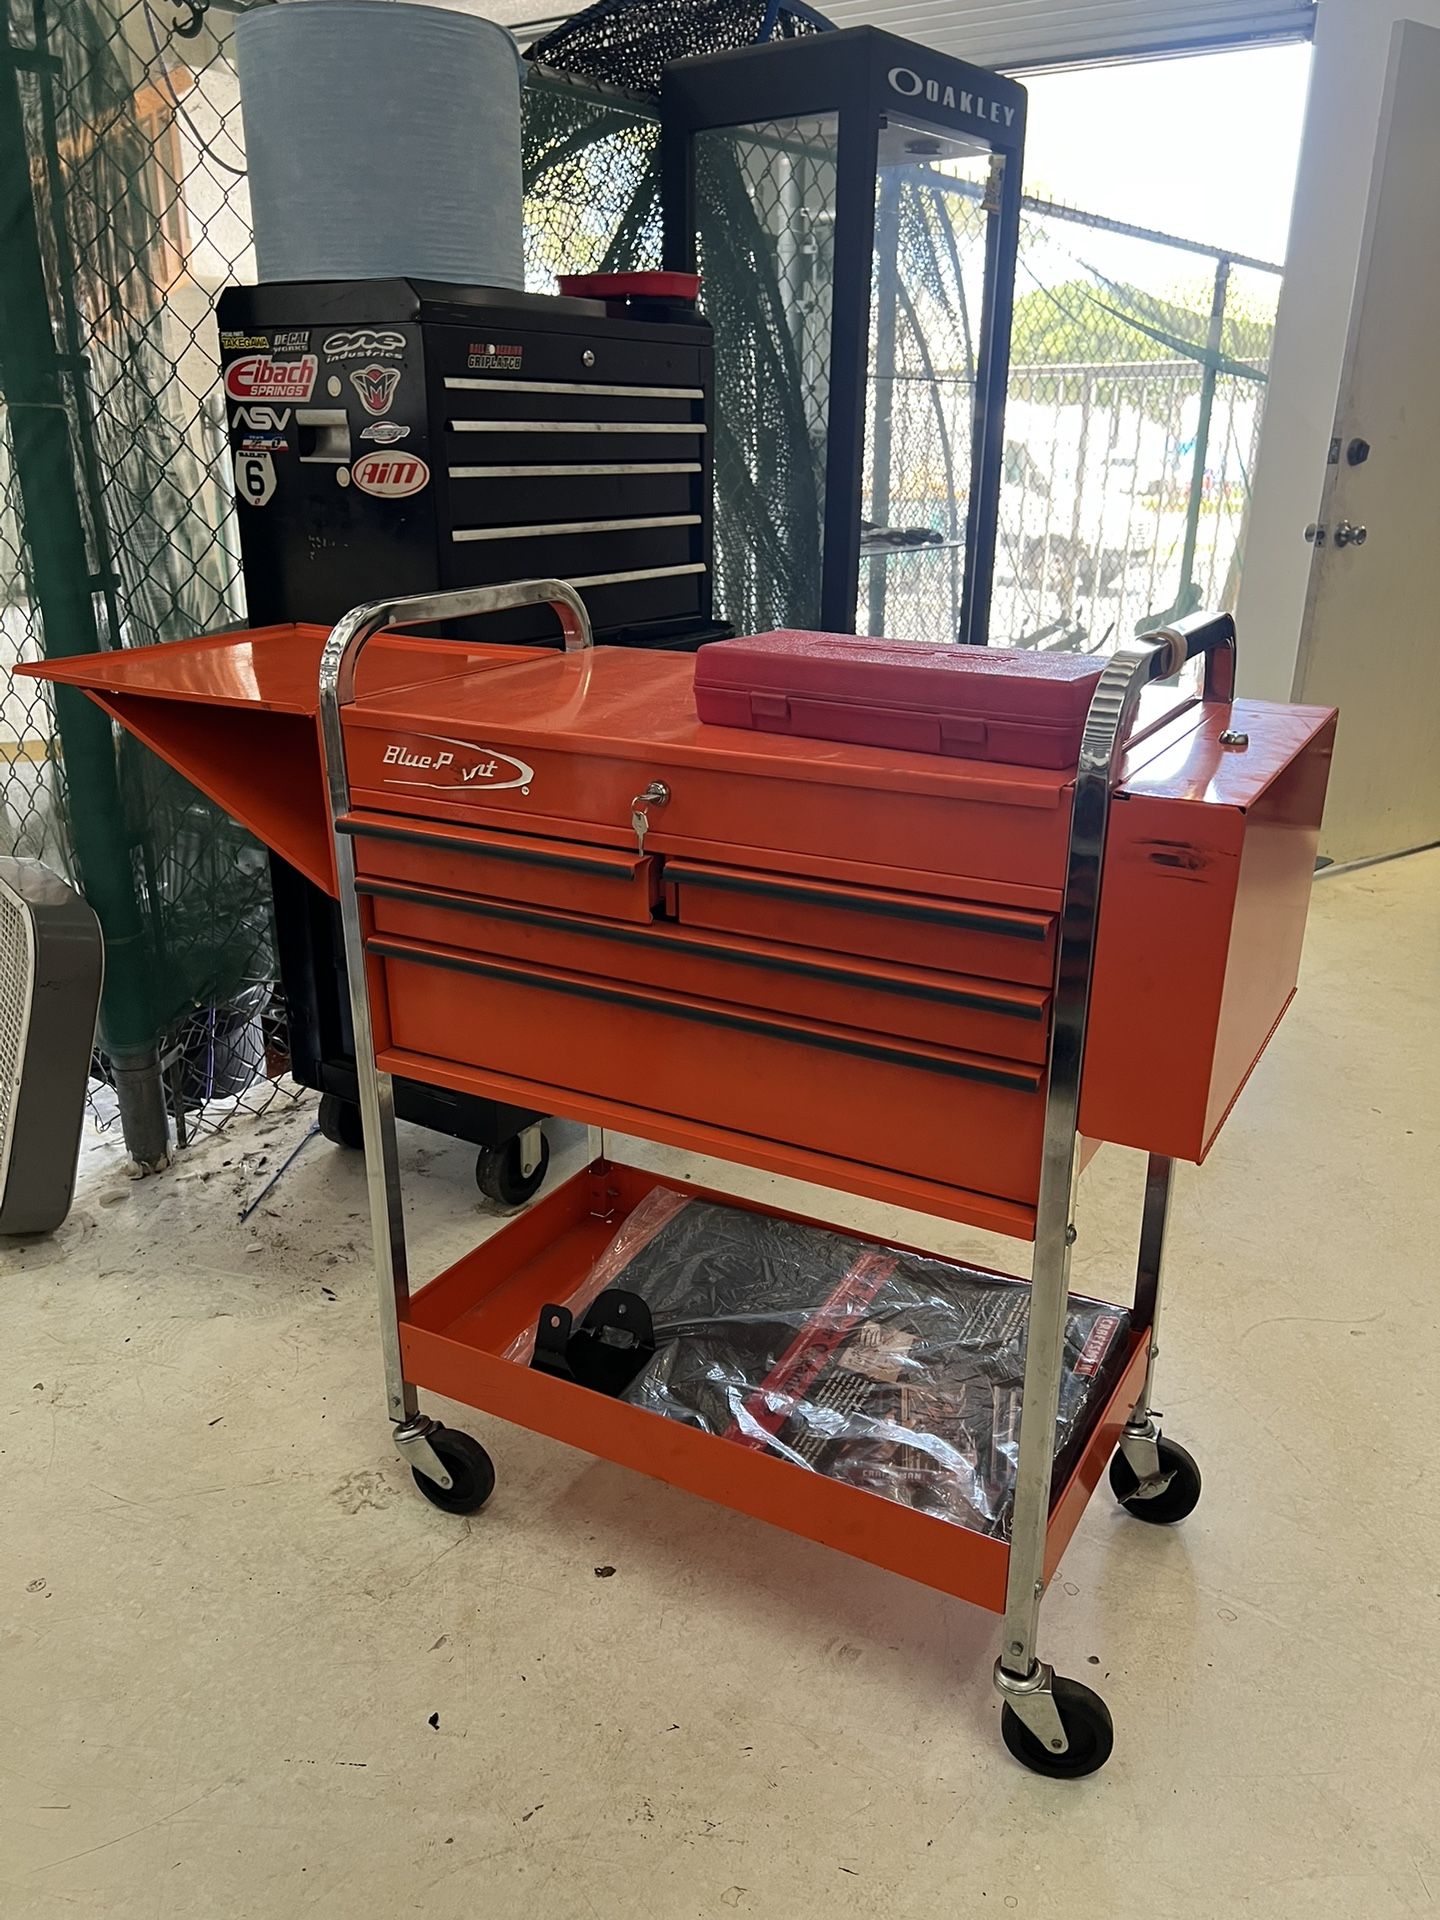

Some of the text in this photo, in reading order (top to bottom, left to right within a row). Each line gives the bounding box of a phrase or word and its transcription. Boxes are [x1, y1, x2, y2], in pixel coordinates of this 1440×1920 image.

[926, 79, 1015, 127] OAKLEY
[221, 336, 270, 349] TAKEGAWA
[274, 331, 310, 346] DECAL
[326, 349, 403, 363] industries
[468, 355, 522, 369] GRIPLATCH
[227, 359, 314, 396] Eibach
[250, 385, 304, 396] SPRINGS
[232, 406, 291, 431] ASV
[246, 460, 265, 496] 6
